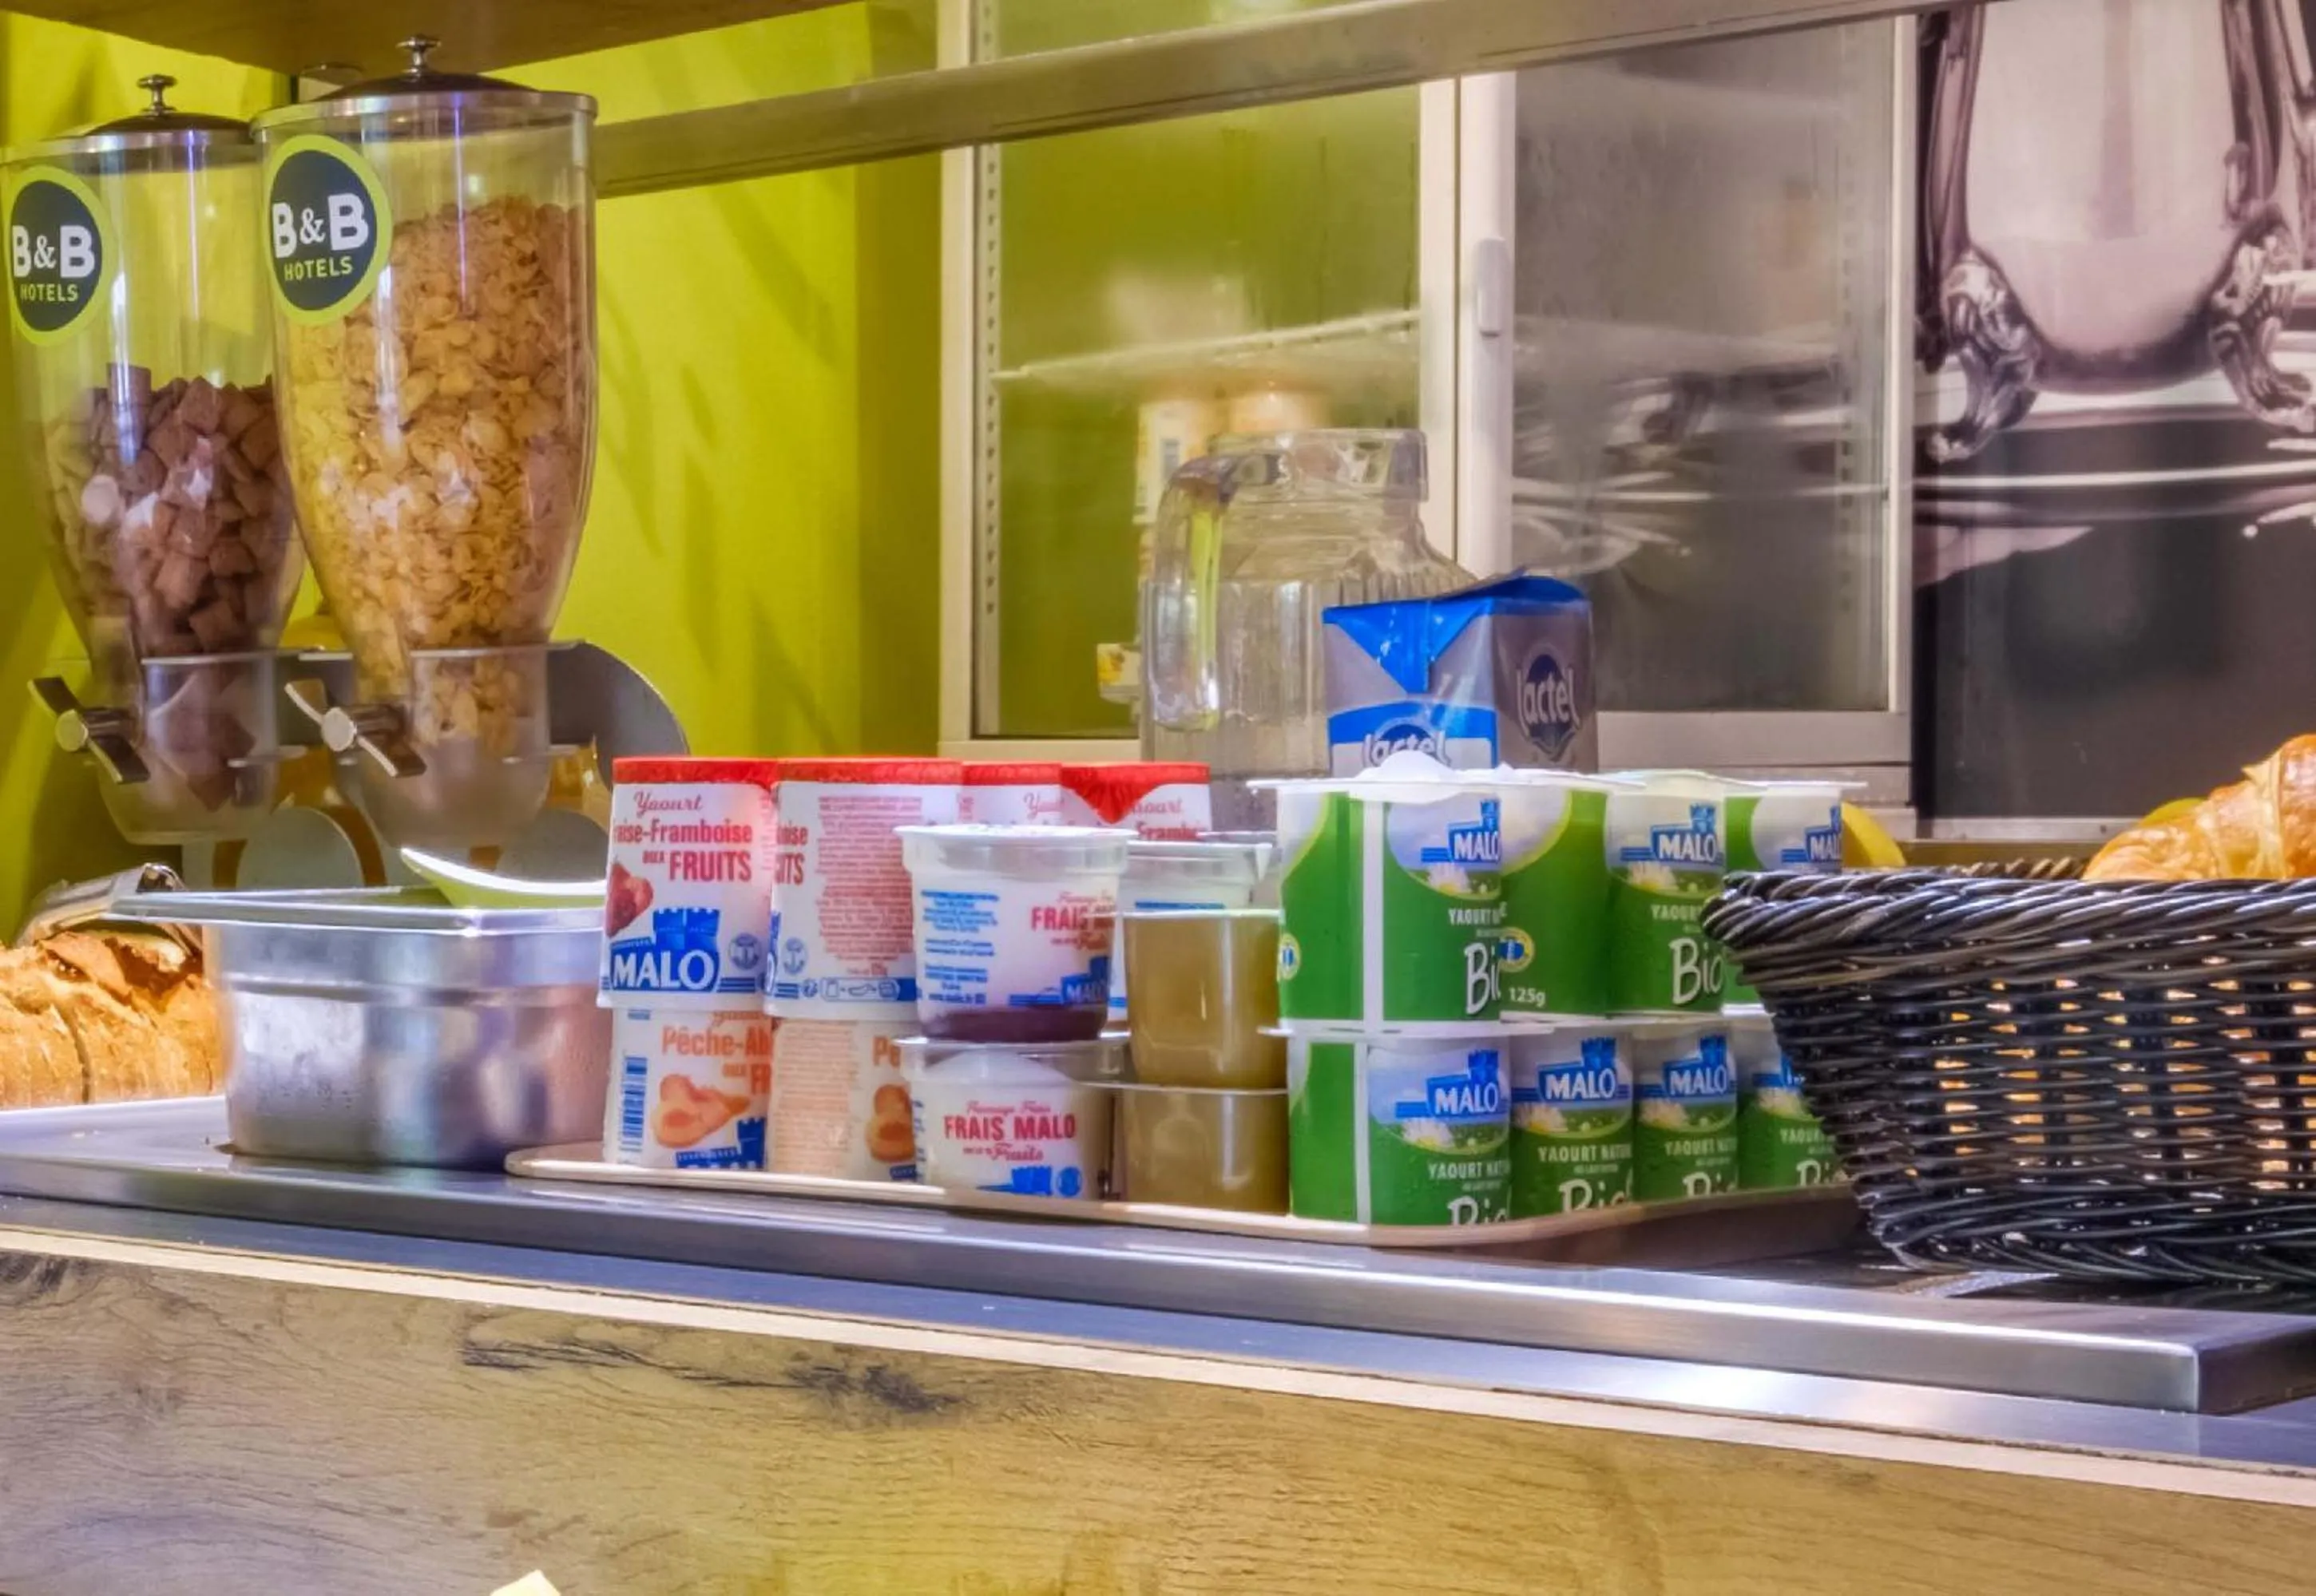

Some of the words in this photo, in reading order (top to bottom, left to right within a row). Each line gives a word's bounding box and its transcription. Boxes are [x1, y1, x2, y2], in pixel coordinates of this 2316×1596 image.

[272, 192, 370, 259] B&B
[12, 225, 95, 279] B&B
[284, 255, 353, 281] HOTELS
[20, 283, 78, 303] HOTELS
[1517, 667, 1580, 734] lactel
[634, 791, 703, 818] Yaourt
[1659, 834, 1717, 862] MALO
[1810, 834, 1840, 860] MAL
[669, 850, 752, 881] FRUITS
[1032, 906, 1089, 930] FRAIS
[613, 949, 715, 990] MALO
[1668, 937, 1723, 1004] Bio
[1509, 987, 1546, 1008] 125g
[1545, 1067, 1618, 1100] MALO
[1669, 1064, 1729, 1096] MALO
[1434, 1083, 1500, 1115] MALO
[944, 1115, 1005, 1141] FRAIS
[1013, 1114, 1076, 1140] MALO
[1538, 1145, 1596, 1162] YAOURT
[1428, 1162, 1482, 1179] YAOURT
